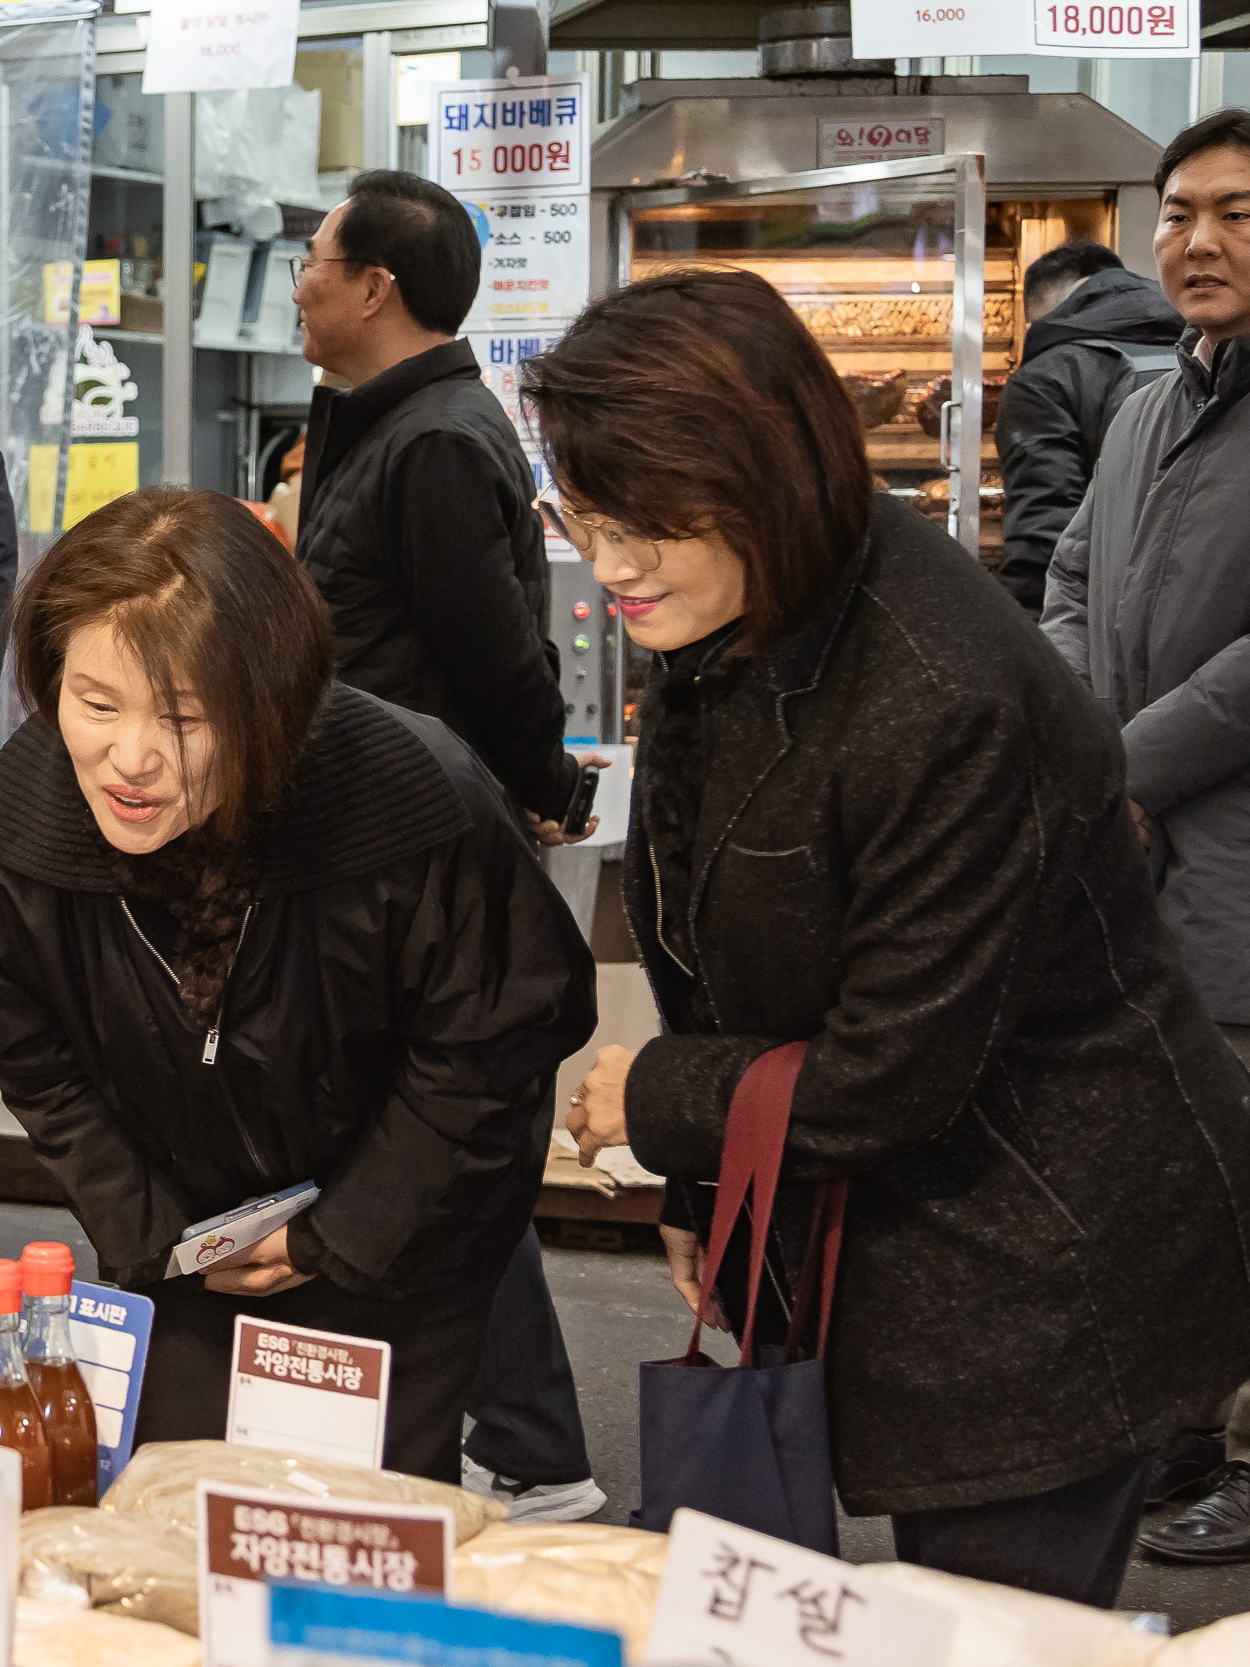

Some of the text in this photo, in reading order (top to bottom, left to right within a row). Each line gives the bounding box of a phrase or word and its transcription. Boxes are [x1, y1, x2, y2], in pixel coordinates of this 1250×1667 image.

[915, 8, 966, 24] 16,000
[1047, 5, 1176, 36] 18,000원
[444, 97, 577, 131] 돼지바베큐
[550, 202, 578, 218] 500
[544, 230, 572, 245] 500
[490, 337, 564, 365] 바베
[78, 1297, 128, 1327] 표시판
[257, 1332, 291, 1353] ESG
[253, 1349, 364, 1391] 자양전통시장
[233, 1504, 290, 1536] ESG
[229, 1531, 420, 1592] 자양전통시장
